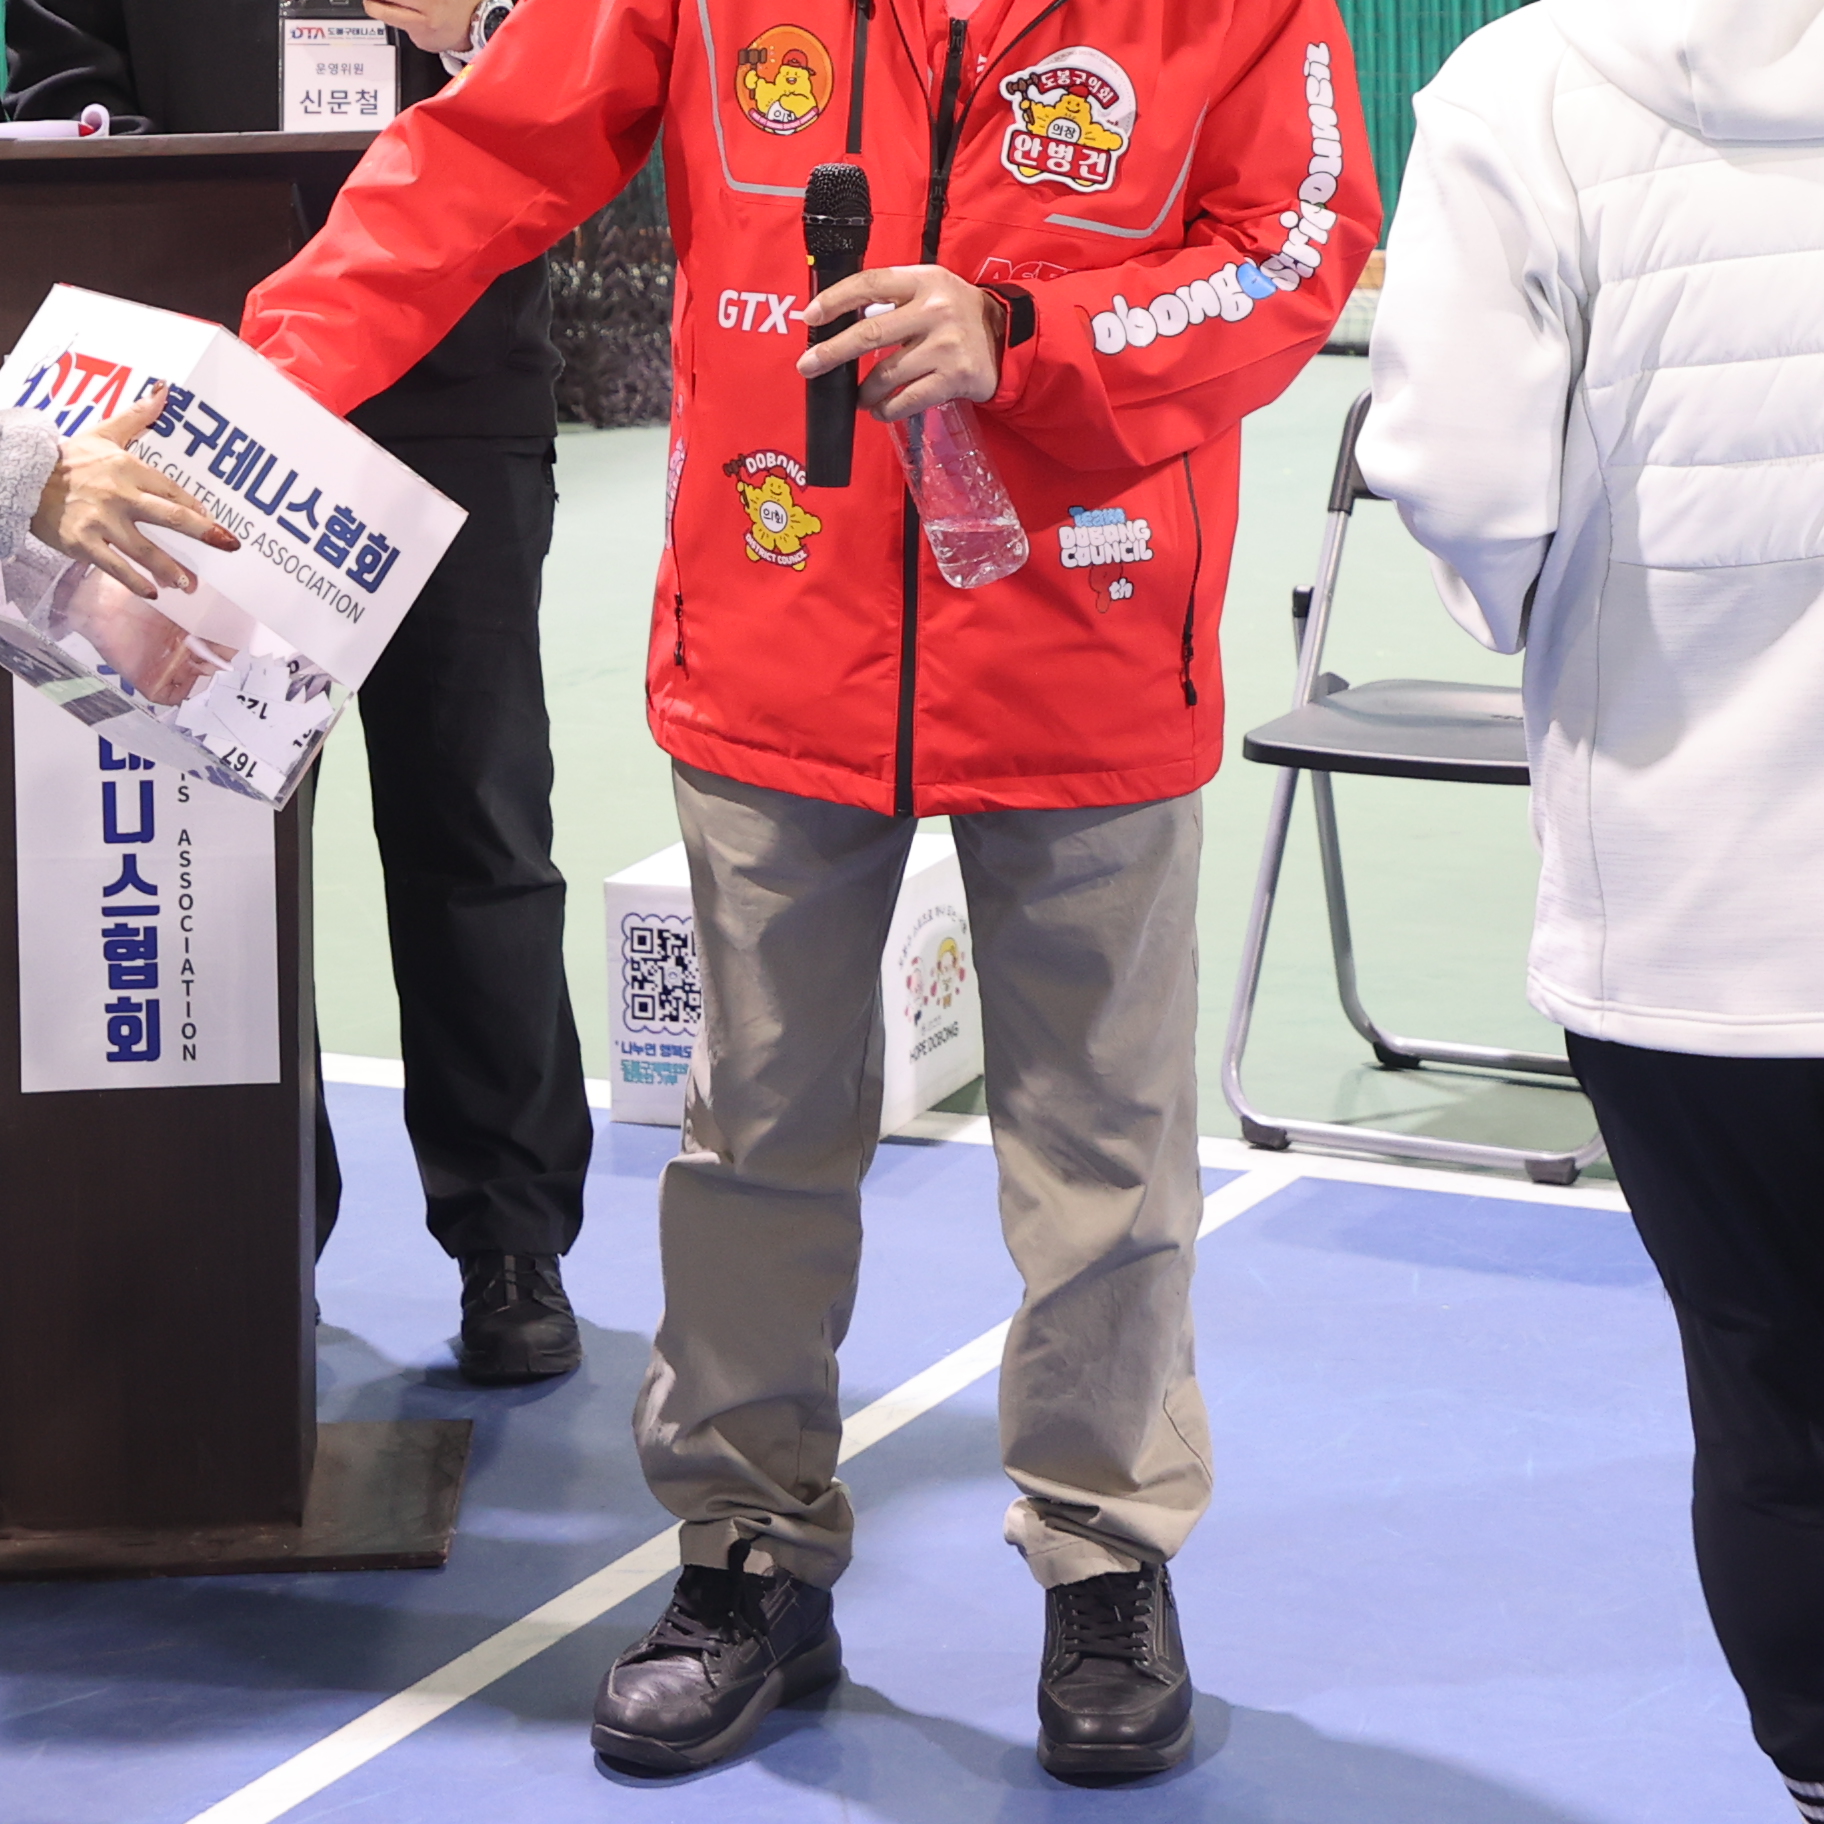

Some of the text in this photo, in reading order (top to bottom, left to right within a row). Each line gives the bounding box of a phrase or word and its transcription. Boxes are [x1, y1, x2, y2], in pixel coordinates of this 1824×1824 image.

[315, 62, 365, 76] 운영위원
[299, 89, 379, 115] 신문철
[1041, 69, 1115, 104] 도봉구의회
[1052, 123, 1076, 139] 의장
[1013, 134, 1108, 182] 안병건
[717, 288, 805, 335] GTX-
[745, 451, 807, 487] DOBONG
[744, 532, 777, 563] DISTRICT
[1058, 518, 1152, 549] DOBONG
[1060, 538, 1154, 569] COUNCIL
[250, 532, 366, 625] ASSOCIATION
[219, 746, 258, 778] 167
[177, 828, 198, 1062] ASSOCIATION
